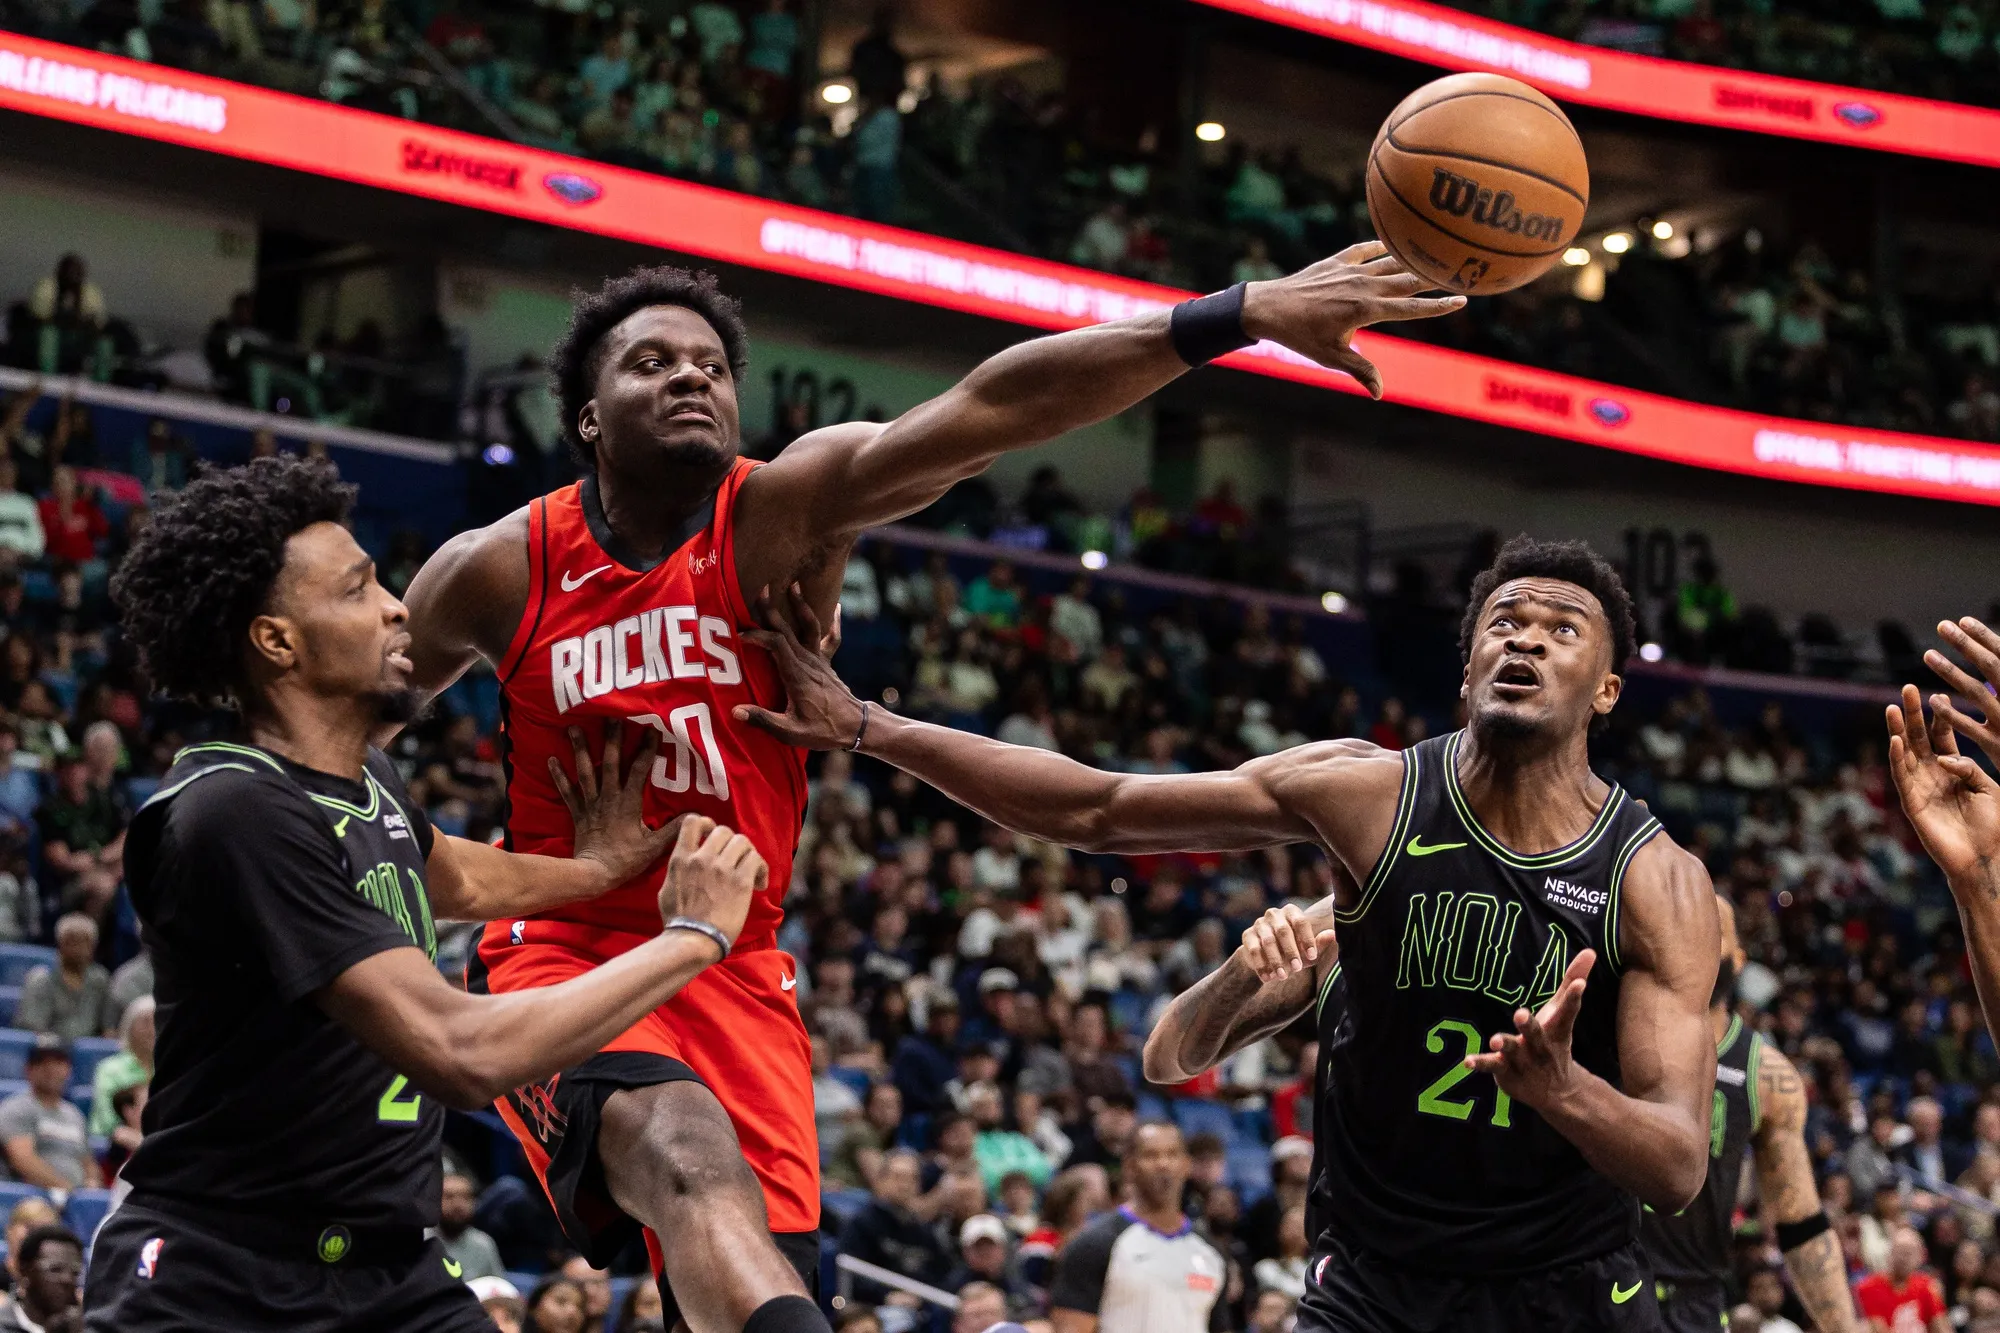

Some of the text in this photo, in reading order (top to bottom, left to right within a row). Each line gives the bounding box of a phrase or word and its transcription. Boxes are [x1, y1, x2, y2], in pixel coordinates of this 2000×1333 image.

[0, 50, 97, 106] RLEANS
[1429, 167, 1565, 243] Wilson
[550, 605, 742, 715] ROCKES
[626, 702, 730, 802] 30
[1544, 876, 1608, 905] NEWAGE
[1546, 892, 1599, 914] PRODUCTS
[1396, 891, 1568, 1014] NOLA
